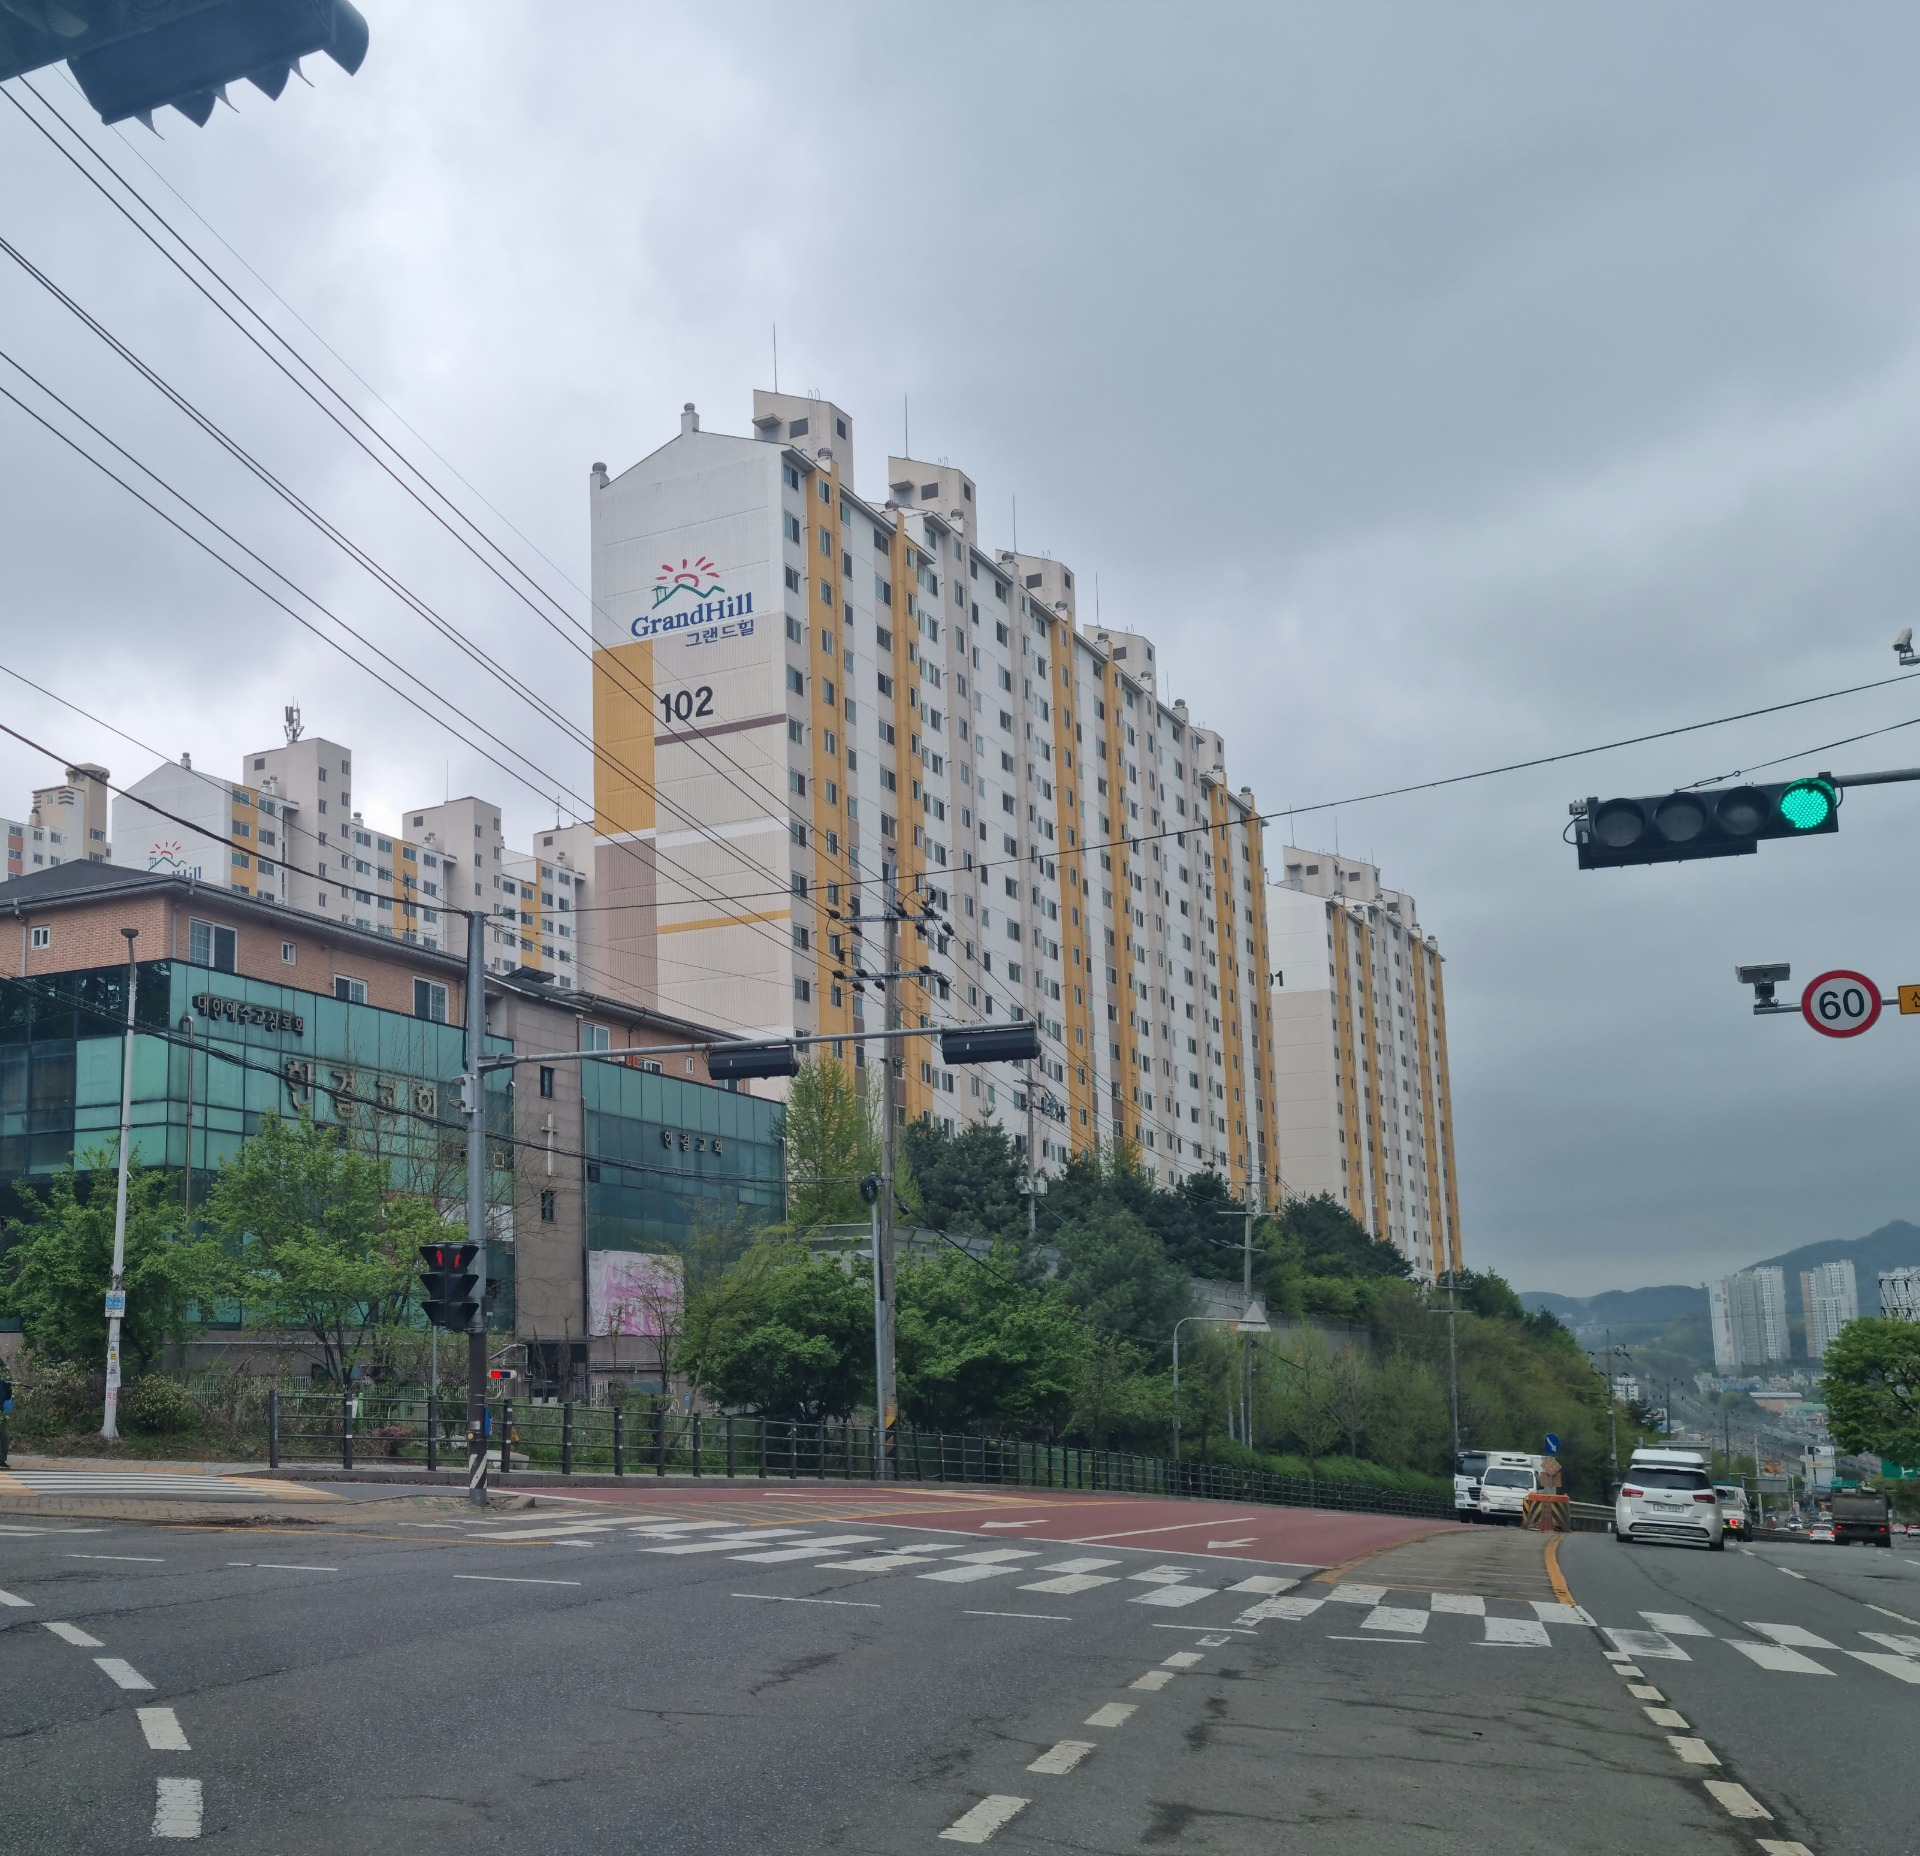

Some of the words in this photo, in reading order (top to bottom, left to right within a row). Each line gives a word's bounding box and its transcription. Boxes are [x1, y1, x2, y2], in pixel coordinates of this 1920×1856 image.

[631, 591, 753, 637] GrandHill
[685, 619, 755, 647] 그랜드힐
[660, 686, 714, 723] 102
[196, 995, 305, 1034] 대한예수교장로회
[1819, 988, 1865, 1020] 60
